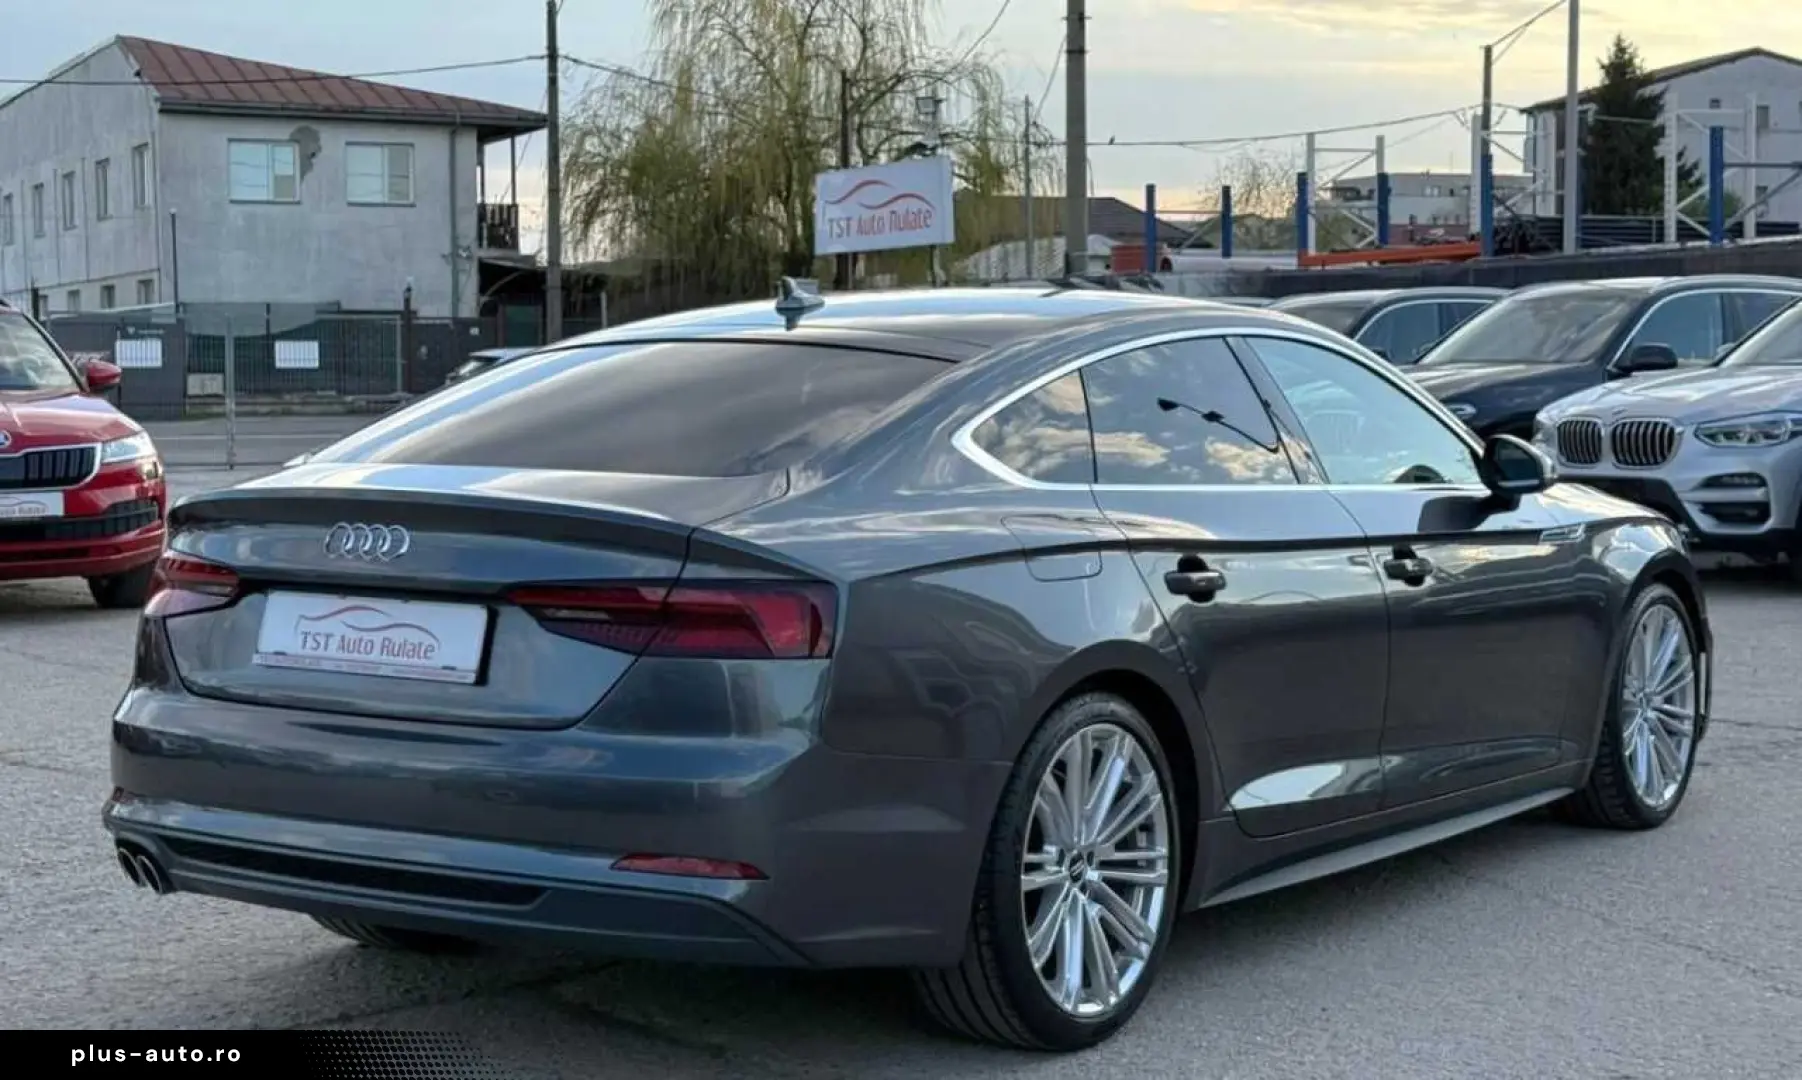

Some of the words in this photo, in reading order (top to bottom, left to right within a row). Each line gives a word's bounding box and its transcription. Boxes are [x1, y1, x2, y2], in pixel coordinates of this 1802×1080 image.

[828, 216, 852, 239] TST
[856, 213, 885, 236] Auto
[300, 630, 332, 652] TST
[337, 633, 375, 656] Auto
[379, 636, 436, 660] Rulate
